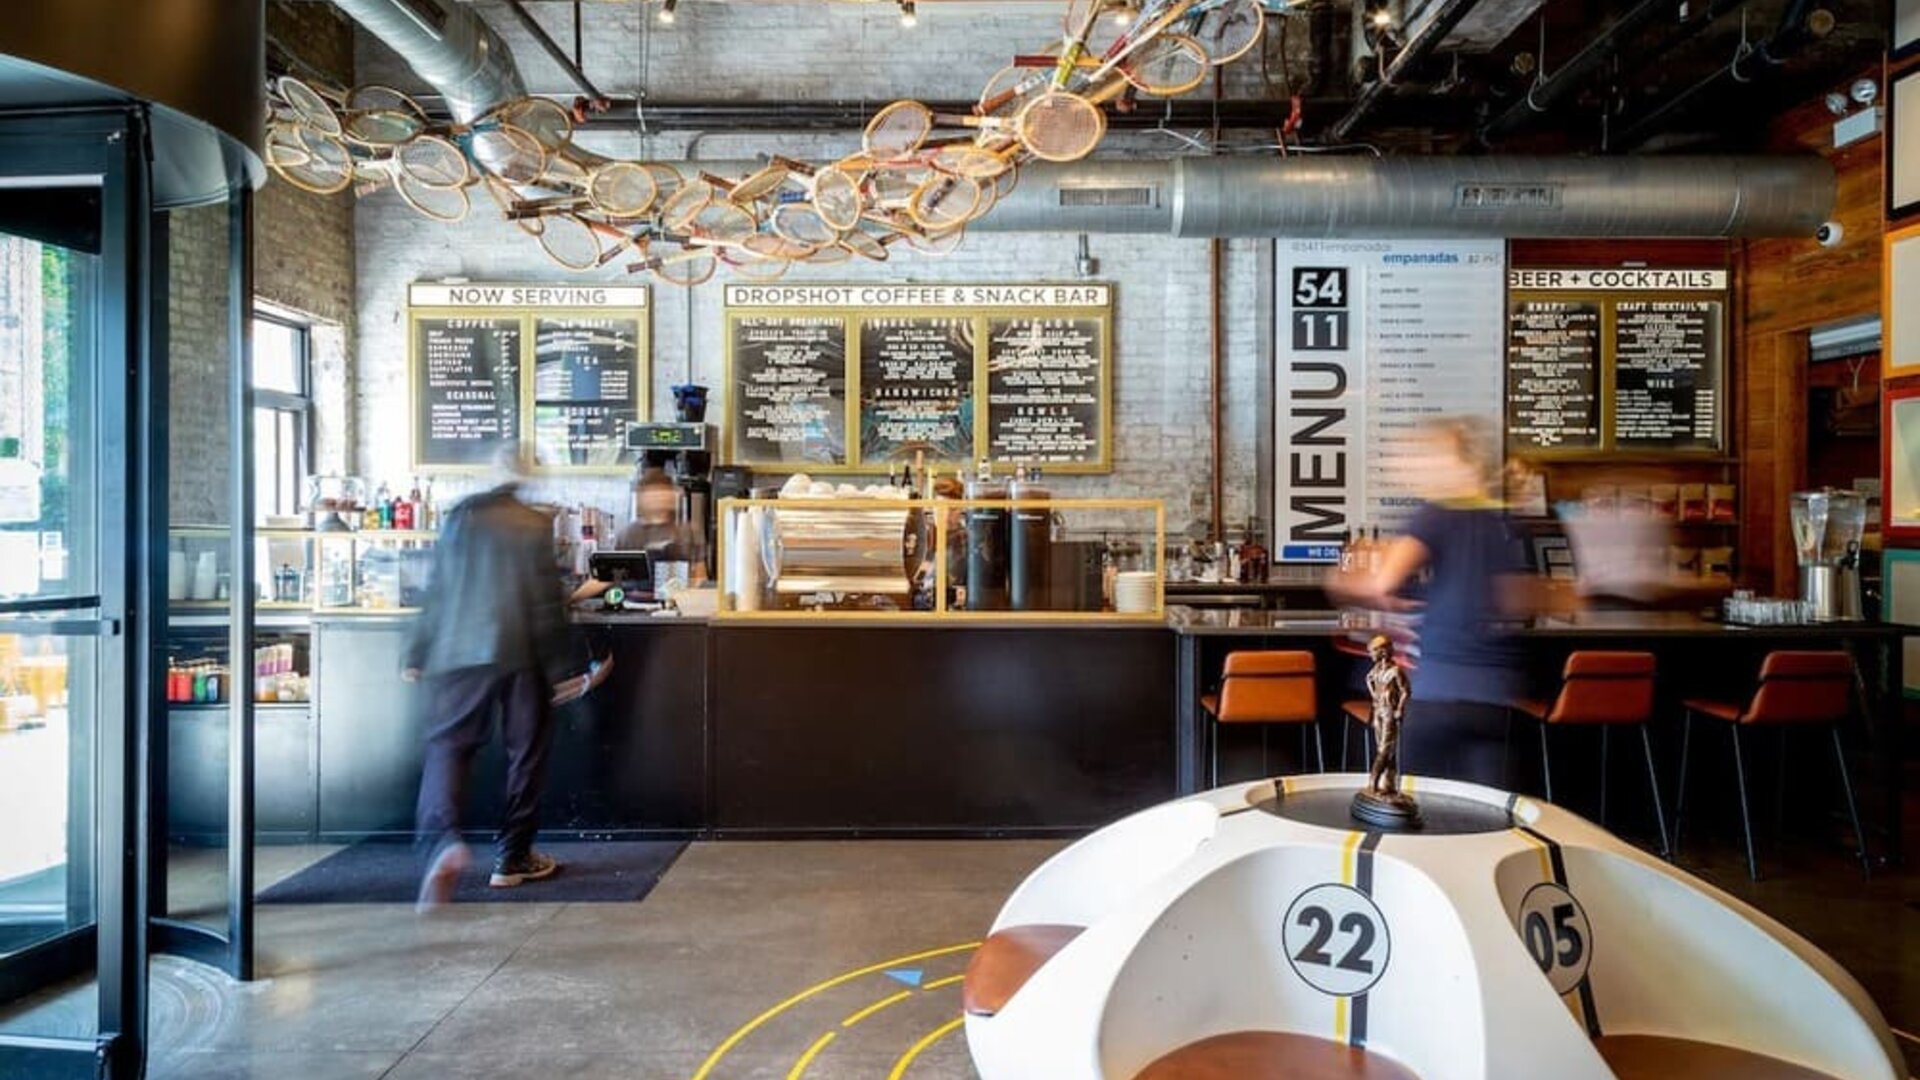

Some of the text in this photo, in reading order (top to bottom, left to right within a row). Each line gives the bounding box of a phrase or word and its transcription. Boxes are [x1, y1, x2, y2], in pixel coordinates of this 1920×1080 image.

[1383, 252, 1459, 265] empanadas
[1510, 272, 1563, 287] BEER
[1589, 271, 1713, 287] COCKTAILS
[735, 288, 1099, 304] DROPSHOT COFFEE & SNACK BAR
[1296, 271, 1342, 305] 54
[449, 289, 607, 304] NOW SERVING
[446, 318, 495, 329] COFFEE
[1301, 314, 1339, 347] 11
[1645, 378, 1675, 389] WINE
[875, 387, 958, 397] SANDWICHES
[1016, 406, 1069, 416] BOWLS
[1289, 362, 1346, 541] MENU
[1293, 905, 1376, 975] 22
[1525, 903, 1584, 973] 05
